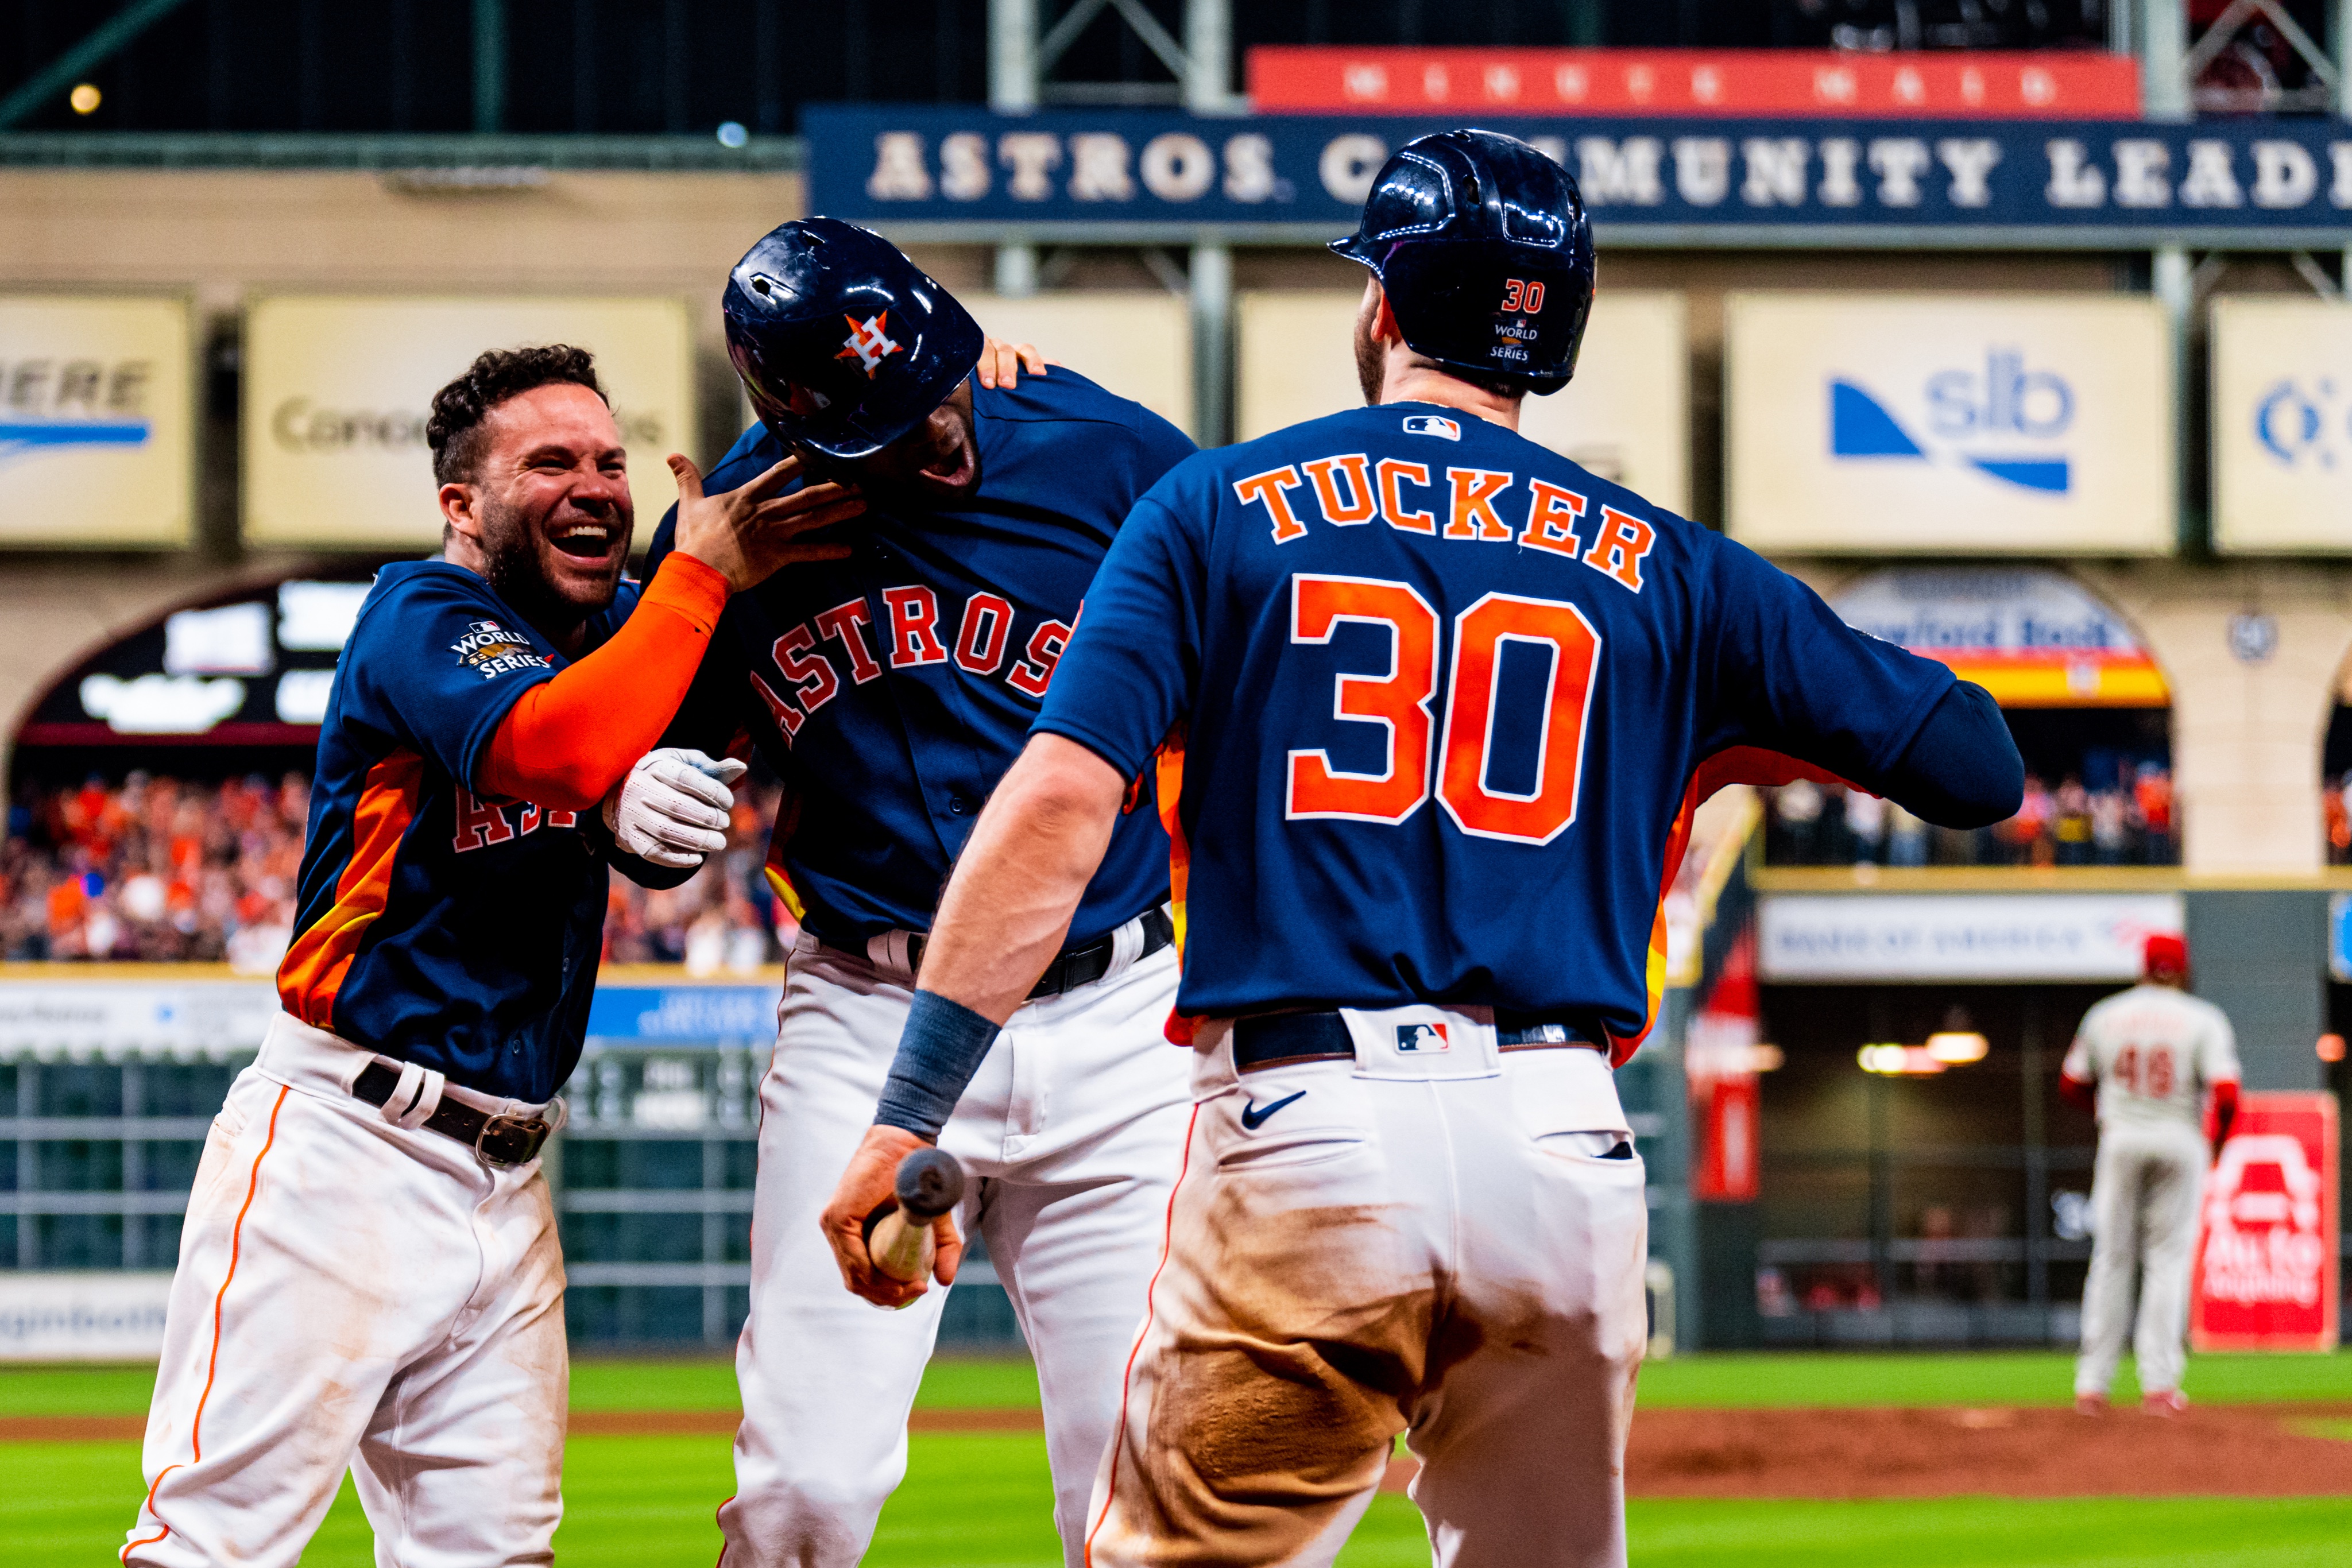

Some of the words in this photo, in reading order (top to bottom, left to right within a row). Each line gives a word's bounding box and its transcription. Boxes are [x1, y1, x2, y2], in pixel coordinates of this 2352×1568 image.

[866, 131, 1276, 203] ASTROS
[1319, 133, 2000, 209] CMUNITY
[1501, 278, 1545, 315] 30
[1495, 324, 1538, 340] WORLD
[1490, 346, 1529, 361] SERIES
[1924, 344, 2077, 440] slb
[1232, 453, 1657, 594] TUCKER
[450, 631, 531, 655] WORLD
[479, 655, 551, 680] SERIES
[1285, 572, 1602, 847] 30
